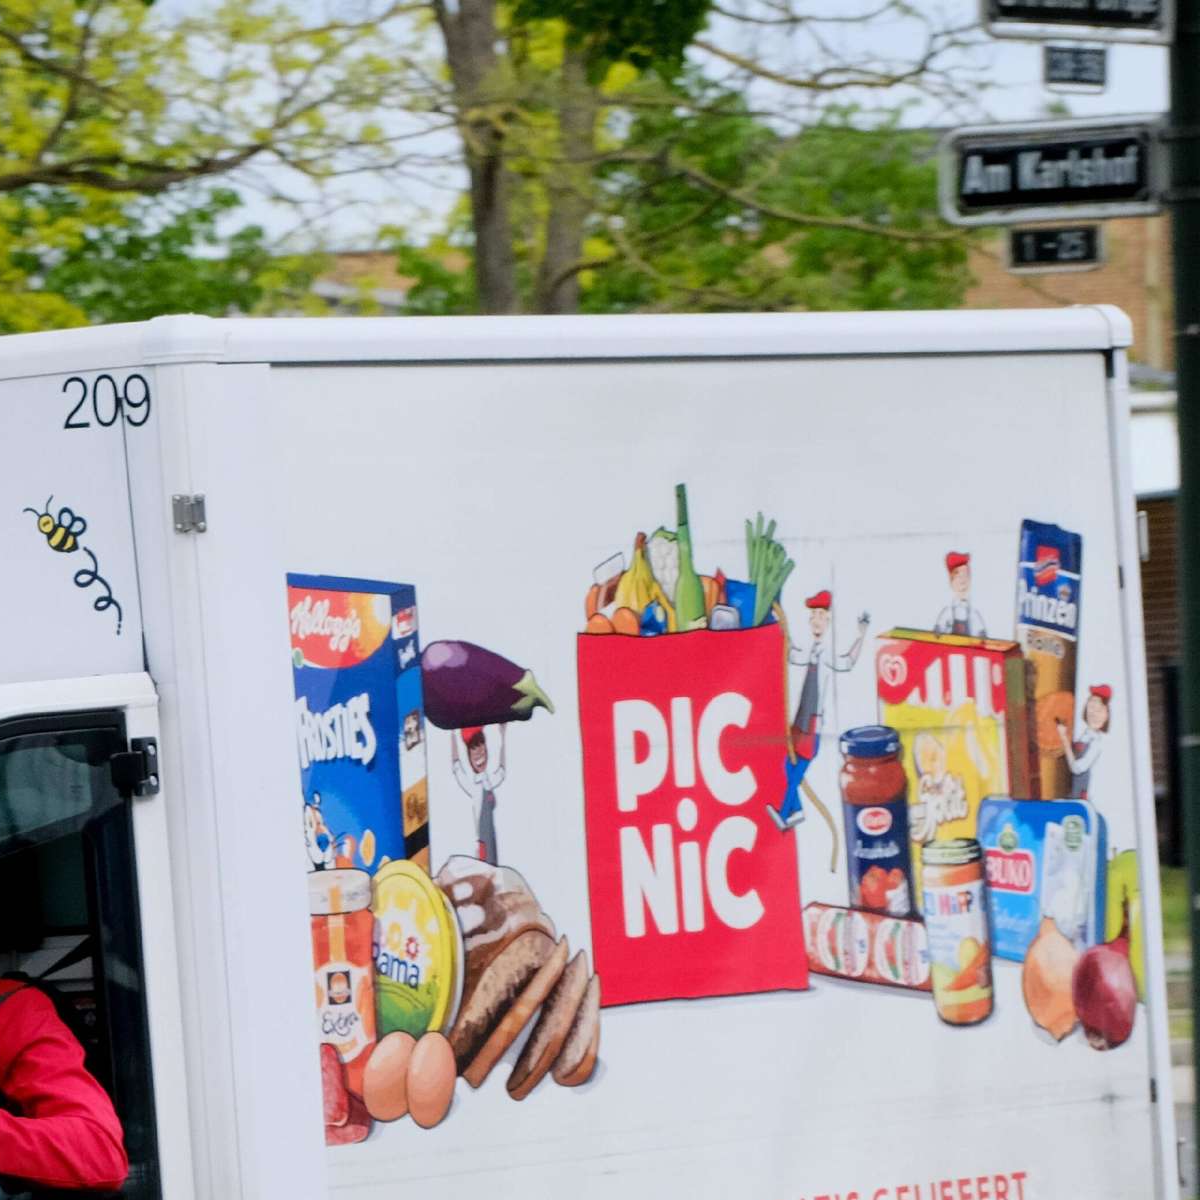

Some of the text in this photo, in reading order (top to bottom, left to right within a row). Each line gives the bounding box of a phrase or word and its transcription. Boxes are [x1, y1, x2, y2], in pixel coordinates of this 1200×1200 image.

[963, 154, 1011, 194] Am
[62, 373, 151, 430] 209
[612, 691, 758, 813] PIC
